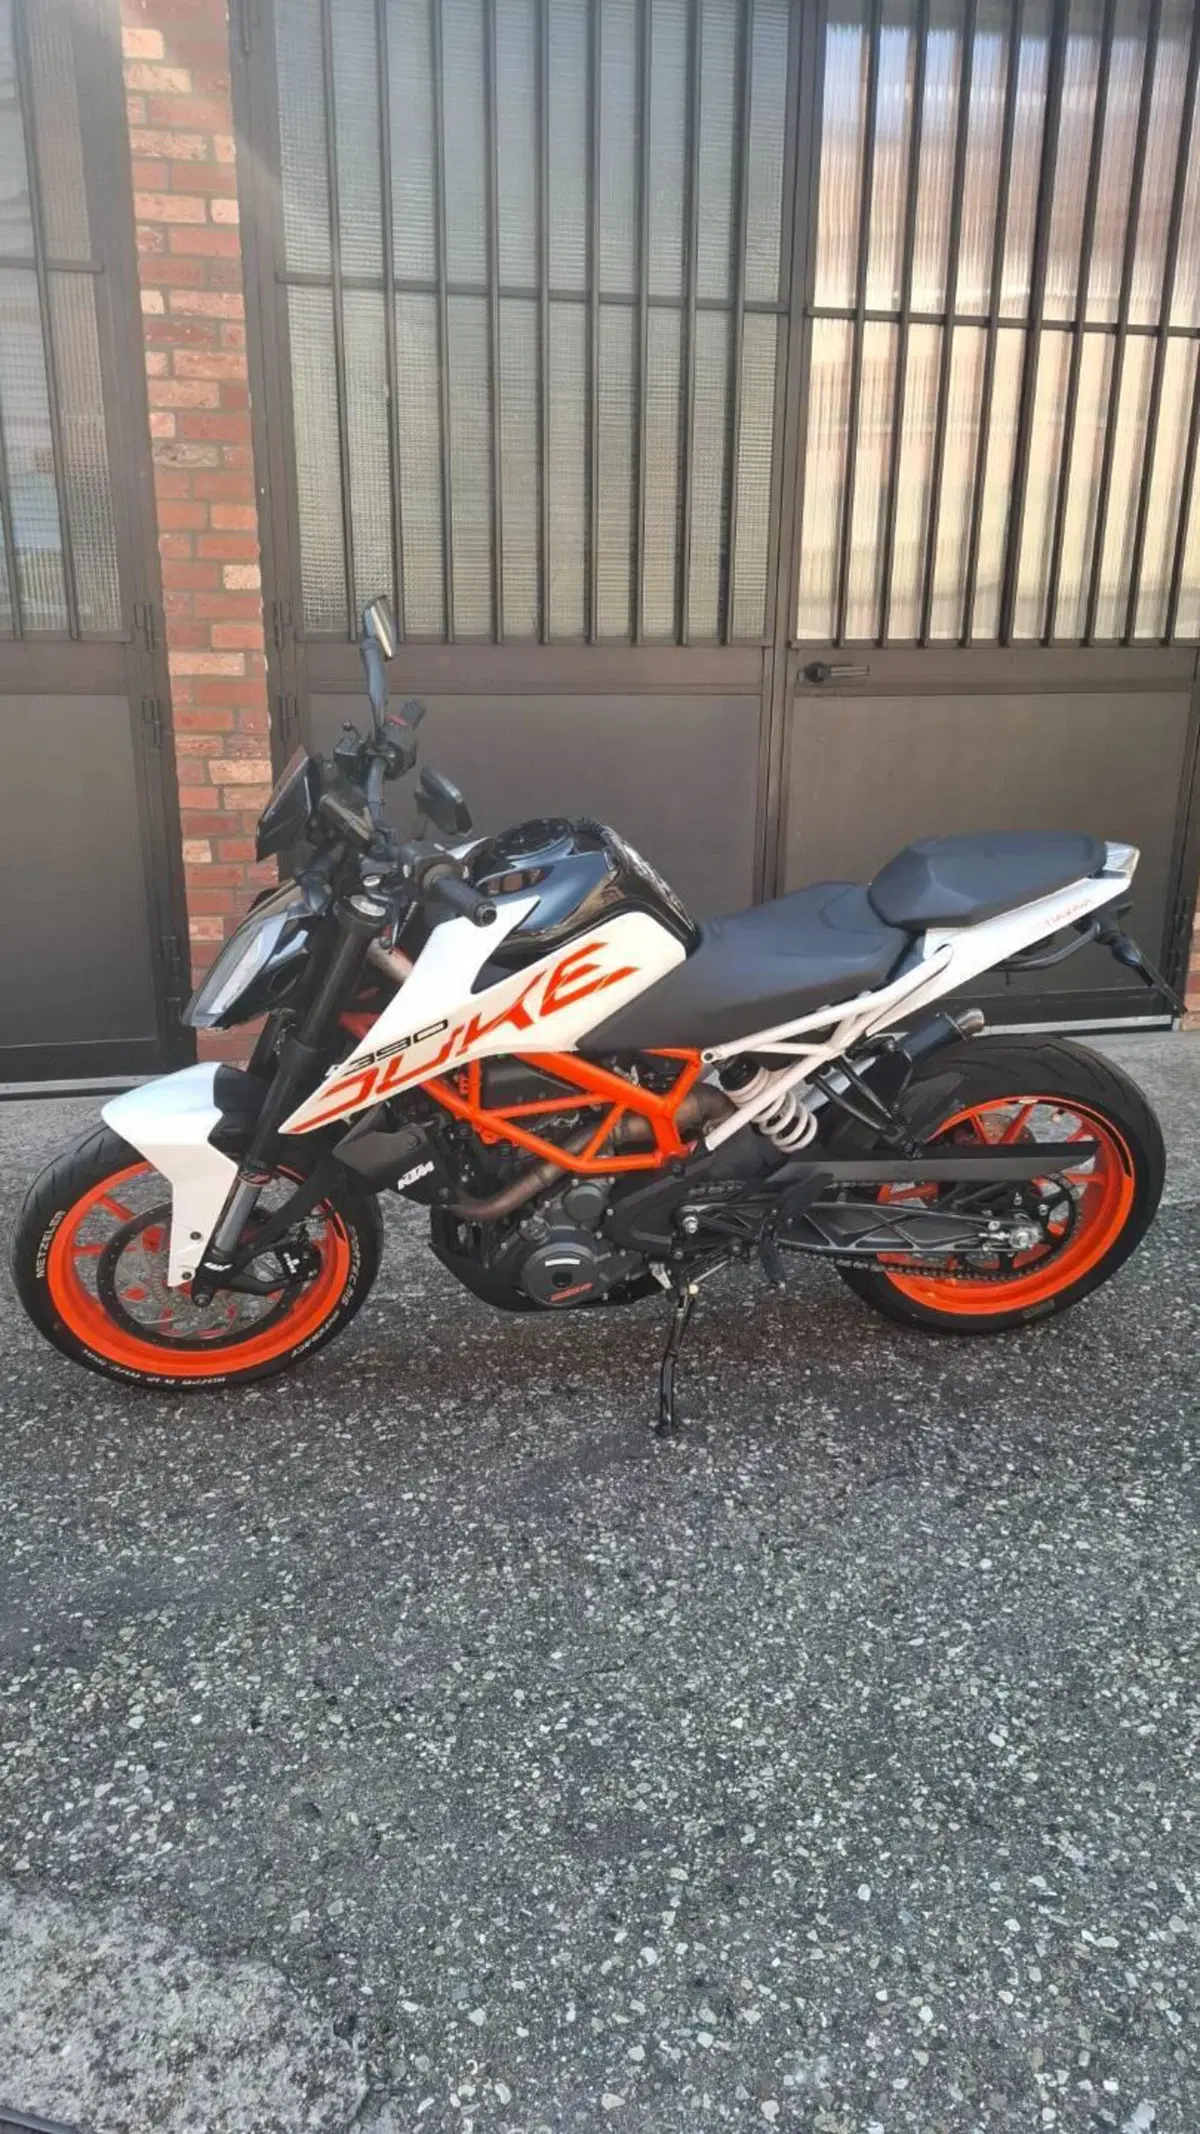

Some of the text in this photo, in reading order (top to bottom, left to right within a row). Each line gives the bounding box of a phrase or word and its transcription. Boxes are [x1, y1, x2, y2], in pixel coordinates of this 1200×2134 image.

[290, 941, 642, 1133] DUKE
[340, 1018, 449, 1077] 390
[397, 1160, 435, 1191] KTM
[35, 1209, 67, 1279] METZELER
